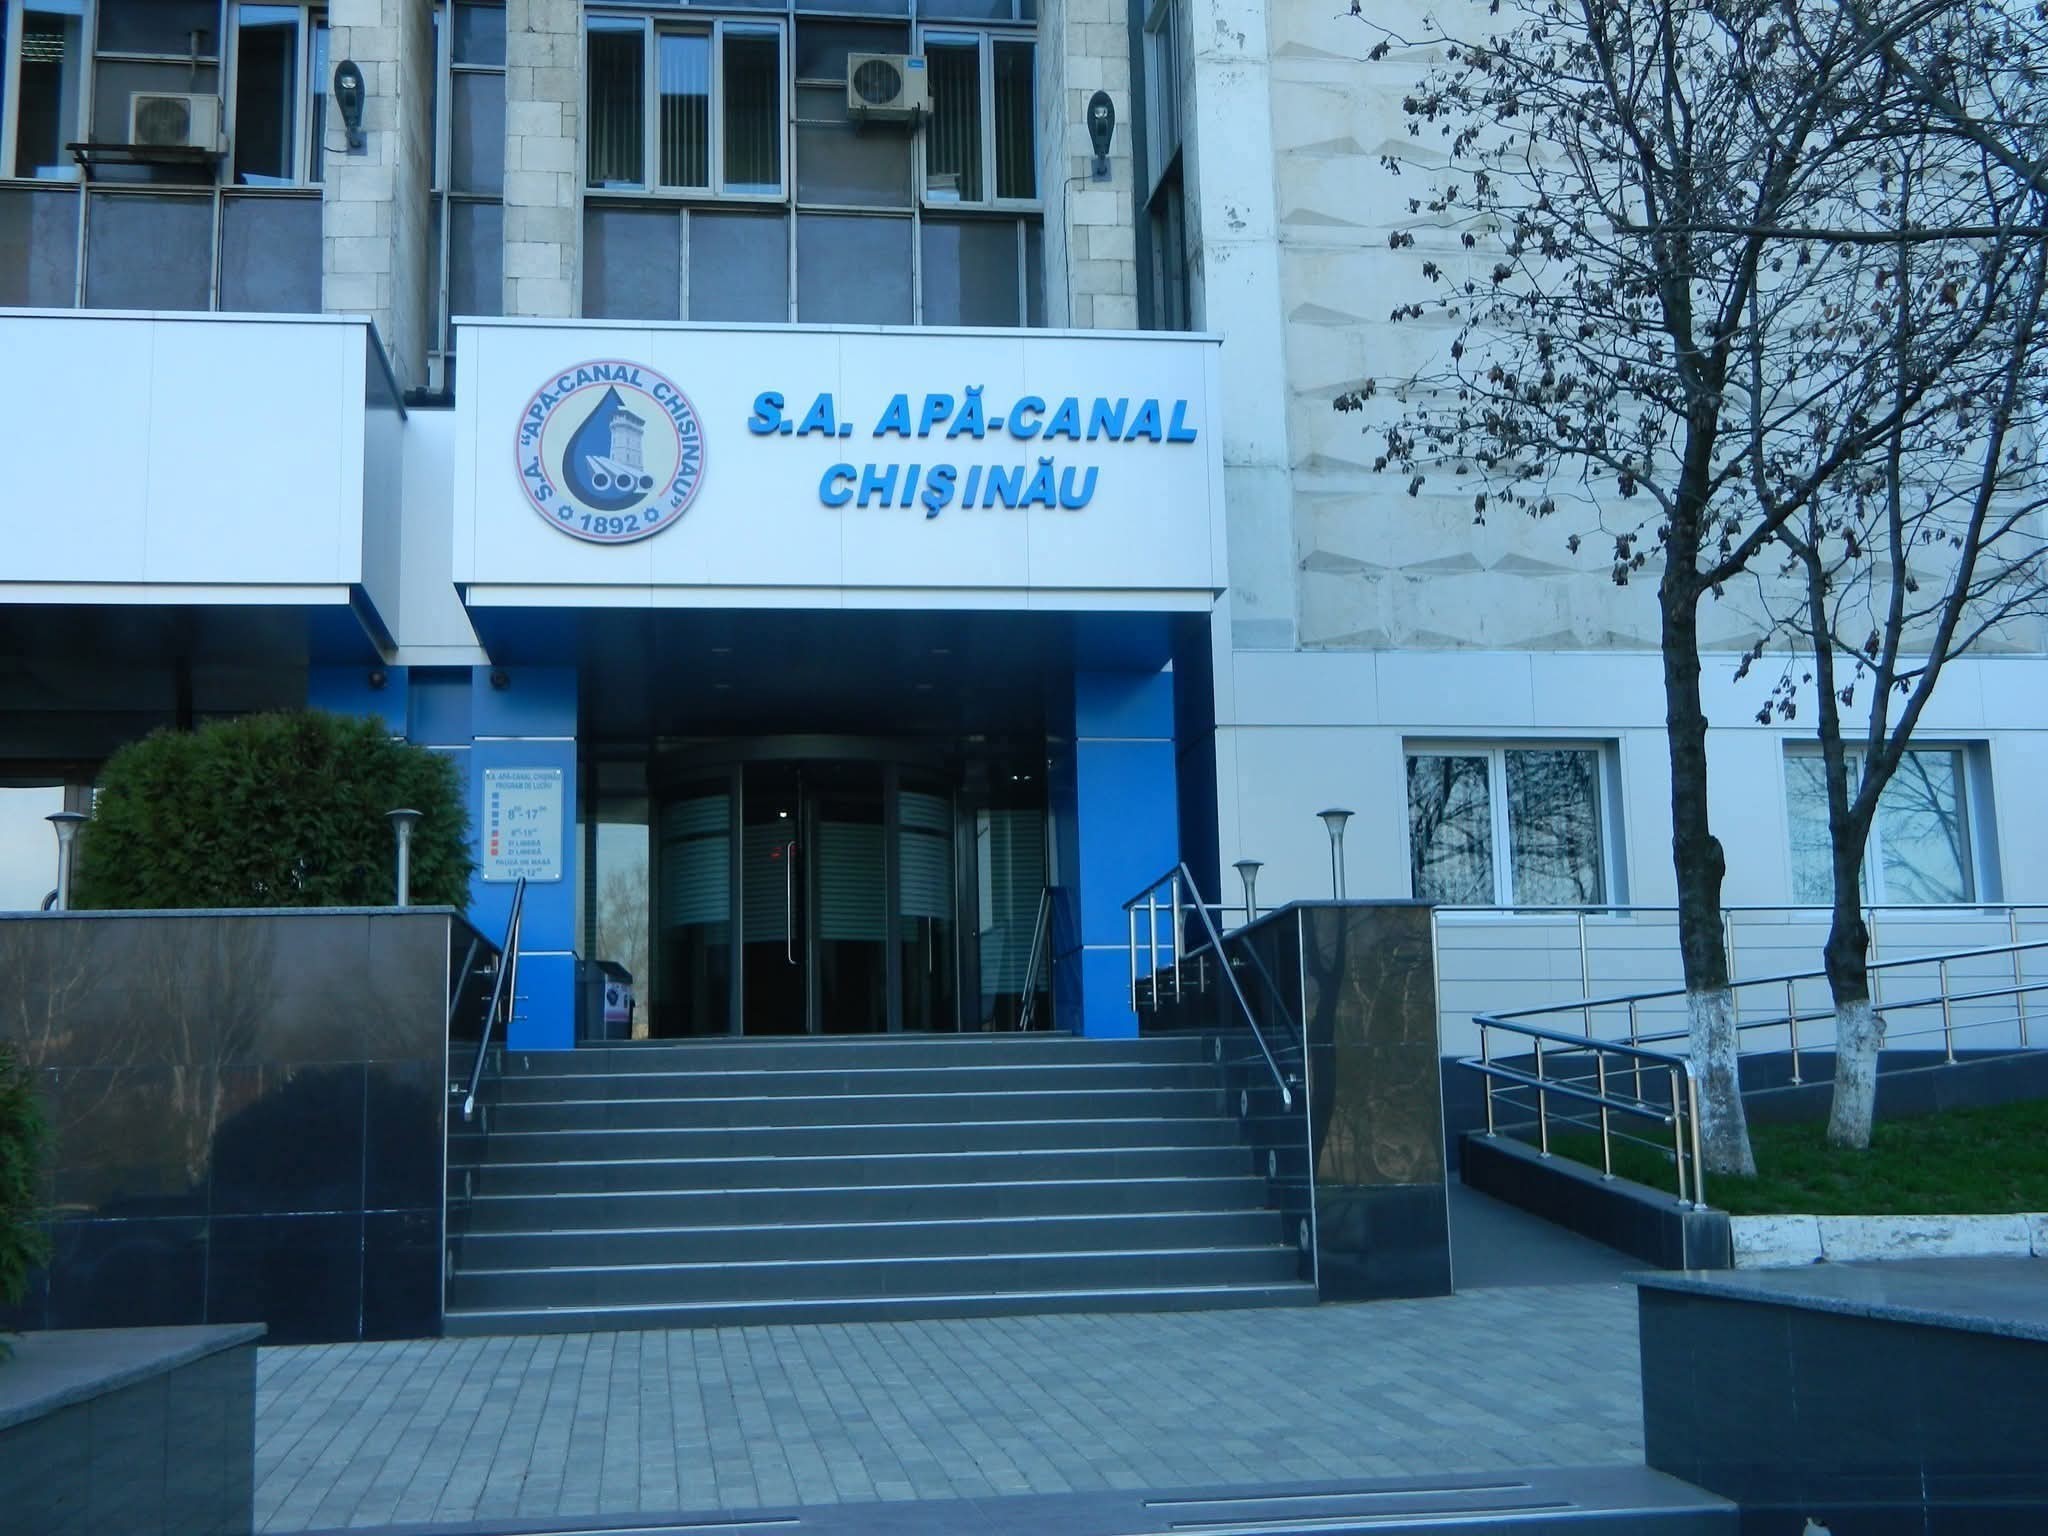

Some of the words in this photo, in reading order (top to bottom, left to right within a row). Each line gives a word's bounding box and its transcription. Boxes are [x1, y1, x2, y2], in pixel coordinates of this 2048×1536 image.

[747, 391, 854, 437] S.A.
[872, 384, 1199, 443] APĂ-CANAL
[524, 456, 553, 502] S.A.
[580, 513, 641, 535] 1892
